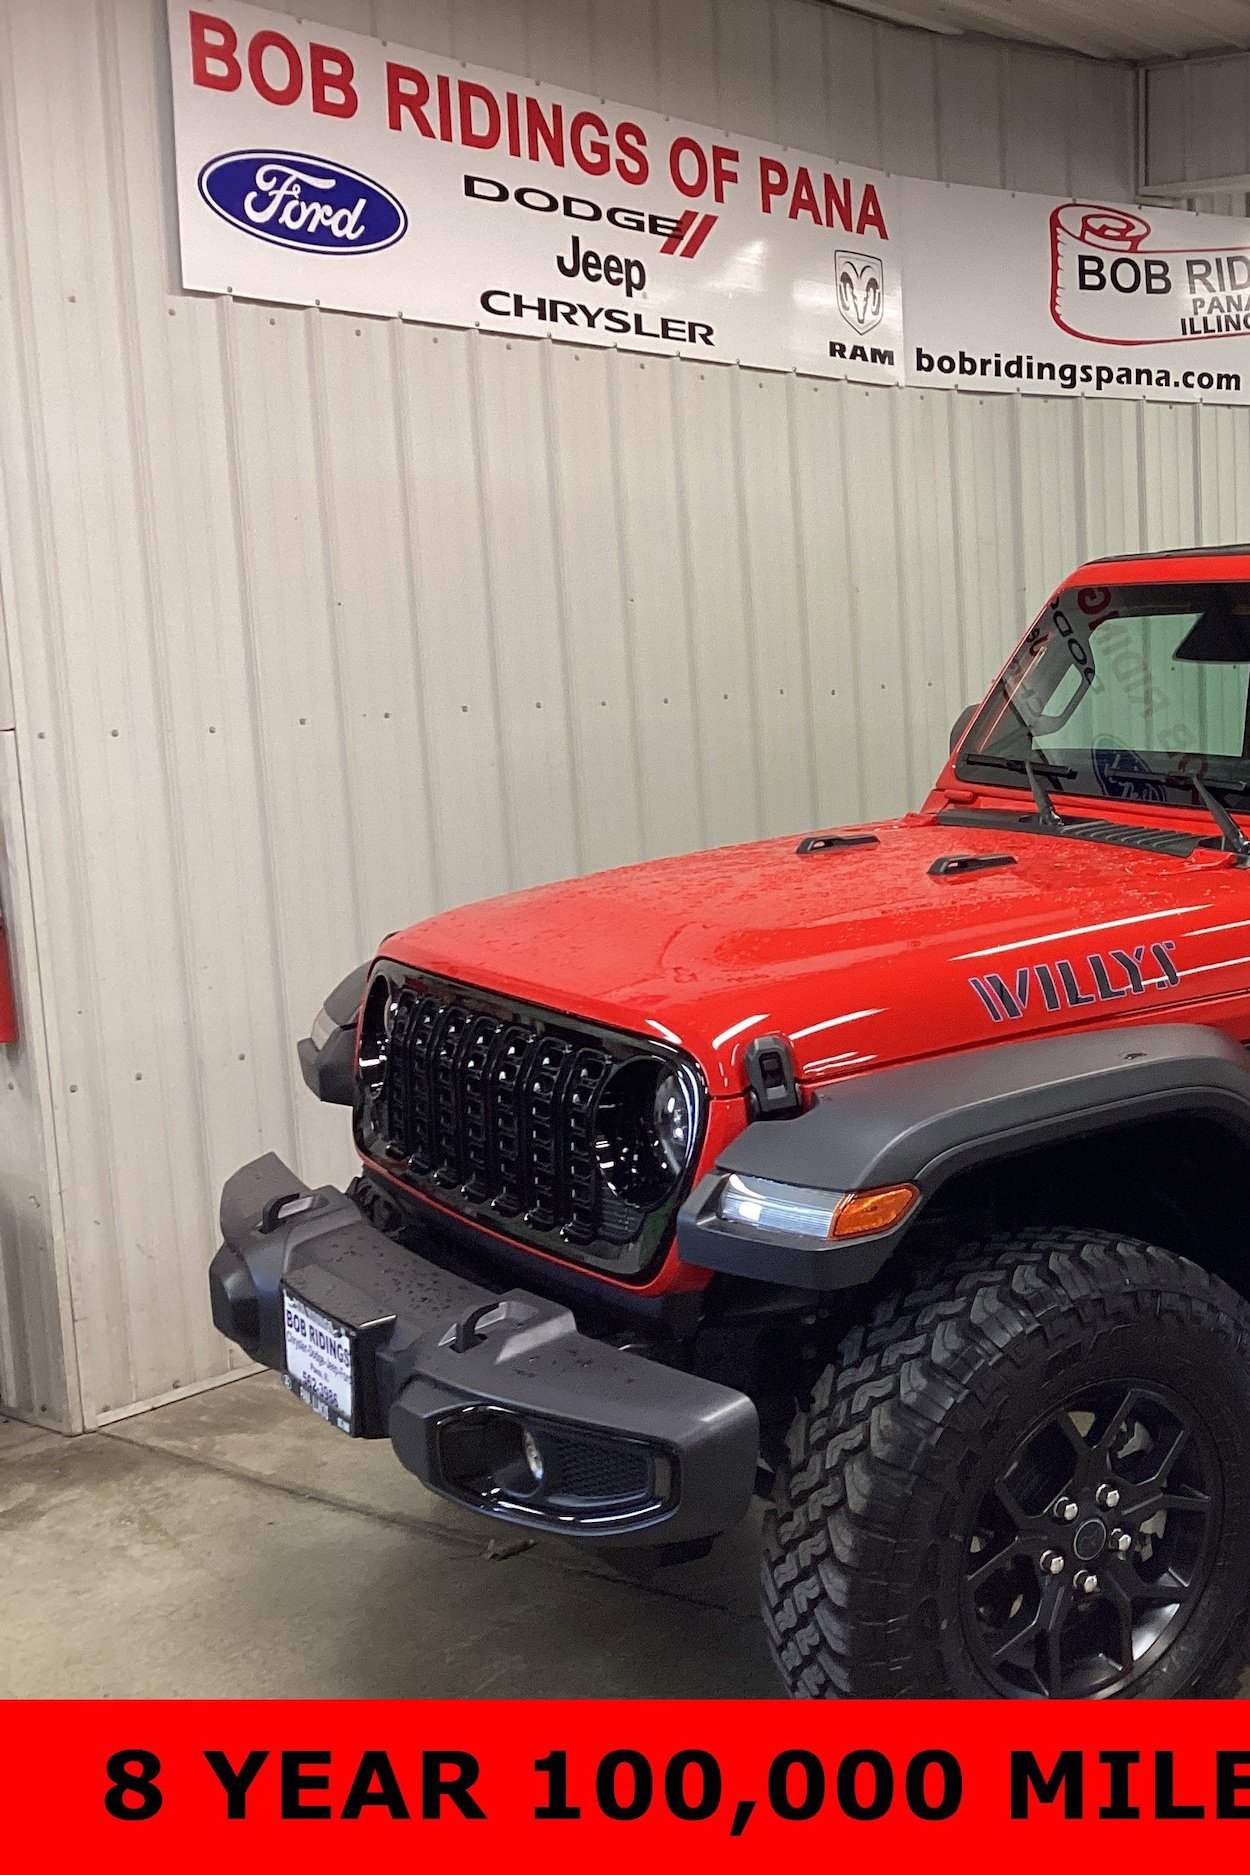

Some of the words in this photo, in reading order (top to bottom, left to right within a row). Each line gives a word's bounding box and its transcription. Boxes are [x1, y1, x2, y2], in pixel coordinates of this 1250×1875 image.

[188, 10, 359, 120] BOB
[385, 61, 650, 186] RIDINGS
[668, 136, 739, 204] OF
[758, 157, 889, 240] PANA
[244, 163, 367, 241] Ford
[463, 175, 684, 240] DODGE
[556, 235, 647, 298] Jeep
[1077, 253, 1172, 295] BOB
[479, 289, 715, 347] CHRYSLER
[829, 341, 895, 367] RAM
[915, 347, 1242, 392] bobridingspana.com
[968, 940, 1181, 1022] WILLYS
[286, 1309, 307, 1338] BOB
[309, 1324, 351, 1369] RIDINGS
